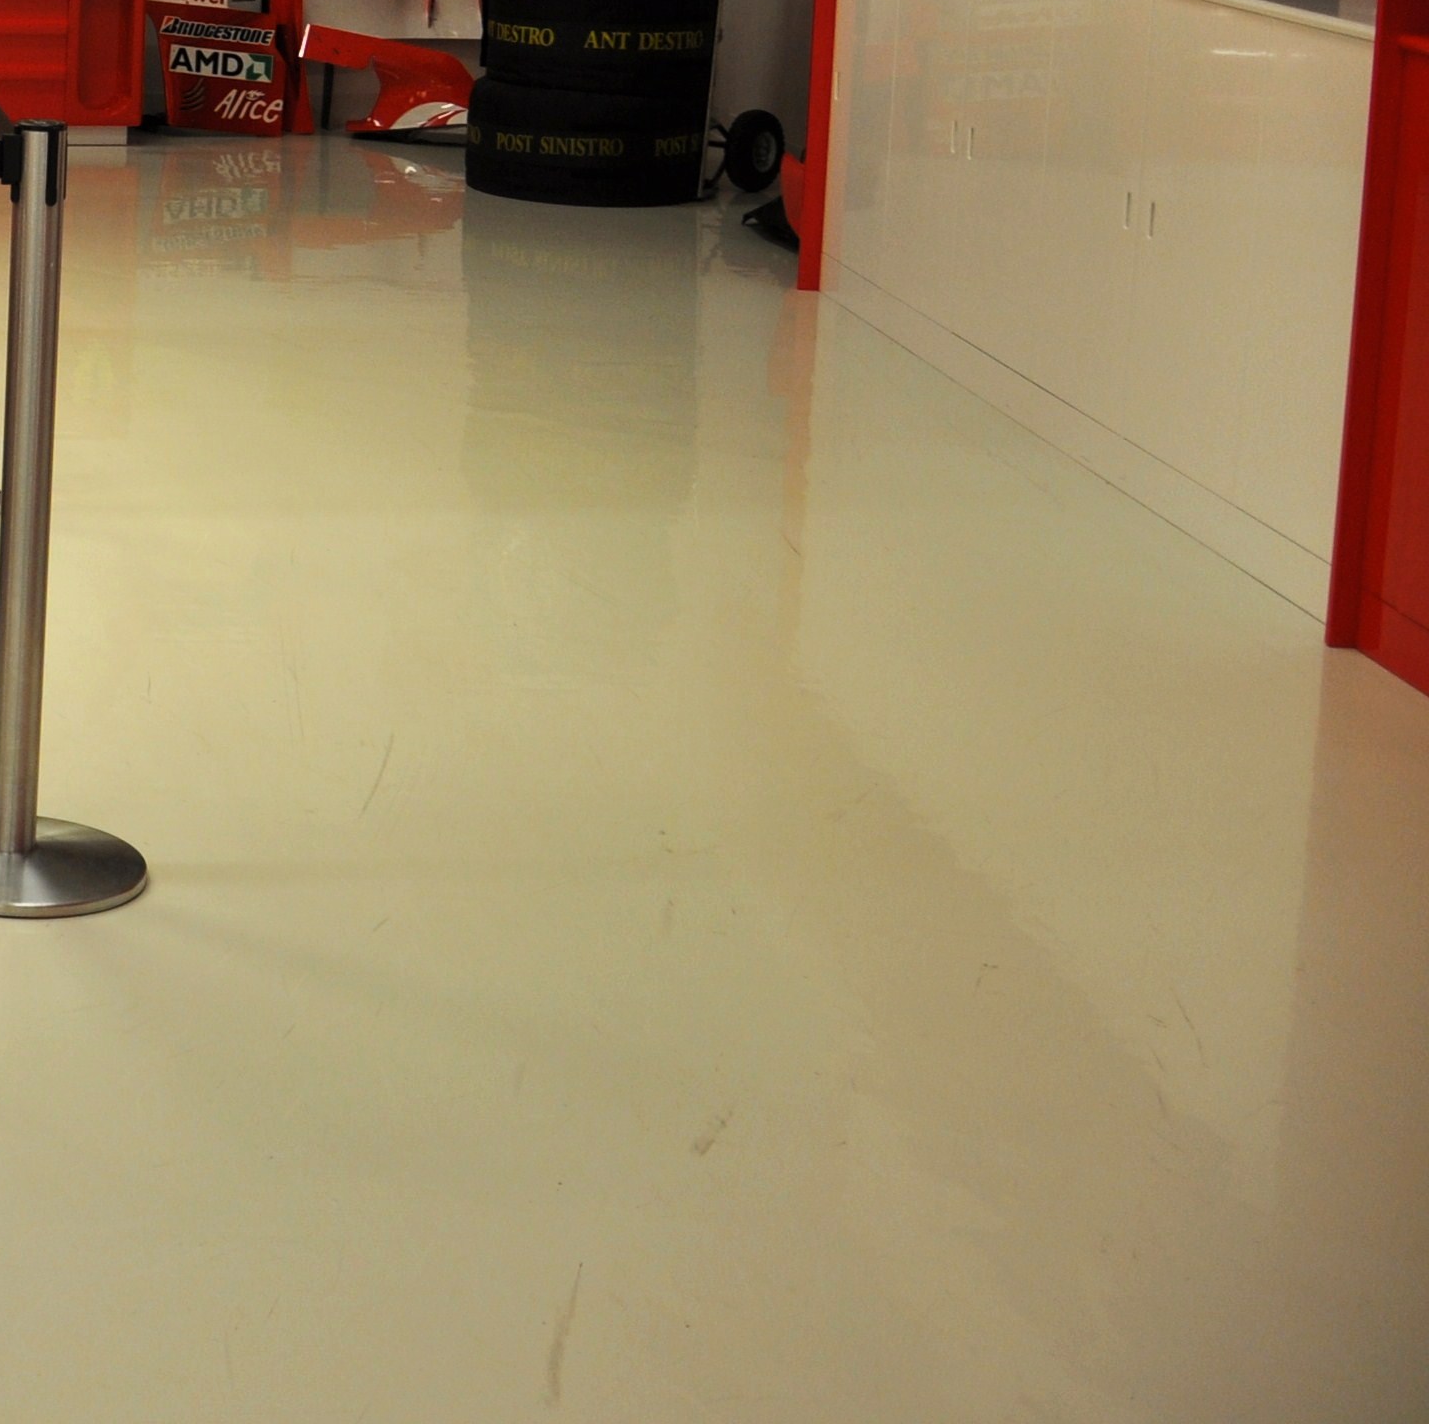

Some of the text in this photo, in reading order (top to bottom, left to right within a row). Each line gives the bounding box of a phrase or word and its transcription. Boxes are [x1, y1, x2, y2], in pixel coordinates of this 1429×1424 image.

[160, 16, 274, 44] BRIDGESTONE
[584, 30, 631, 50] ANT
[170, 47, 244, 77] AMD
[214, 89, 284, 123] Alice
[496, 132, 534, 153] POST
